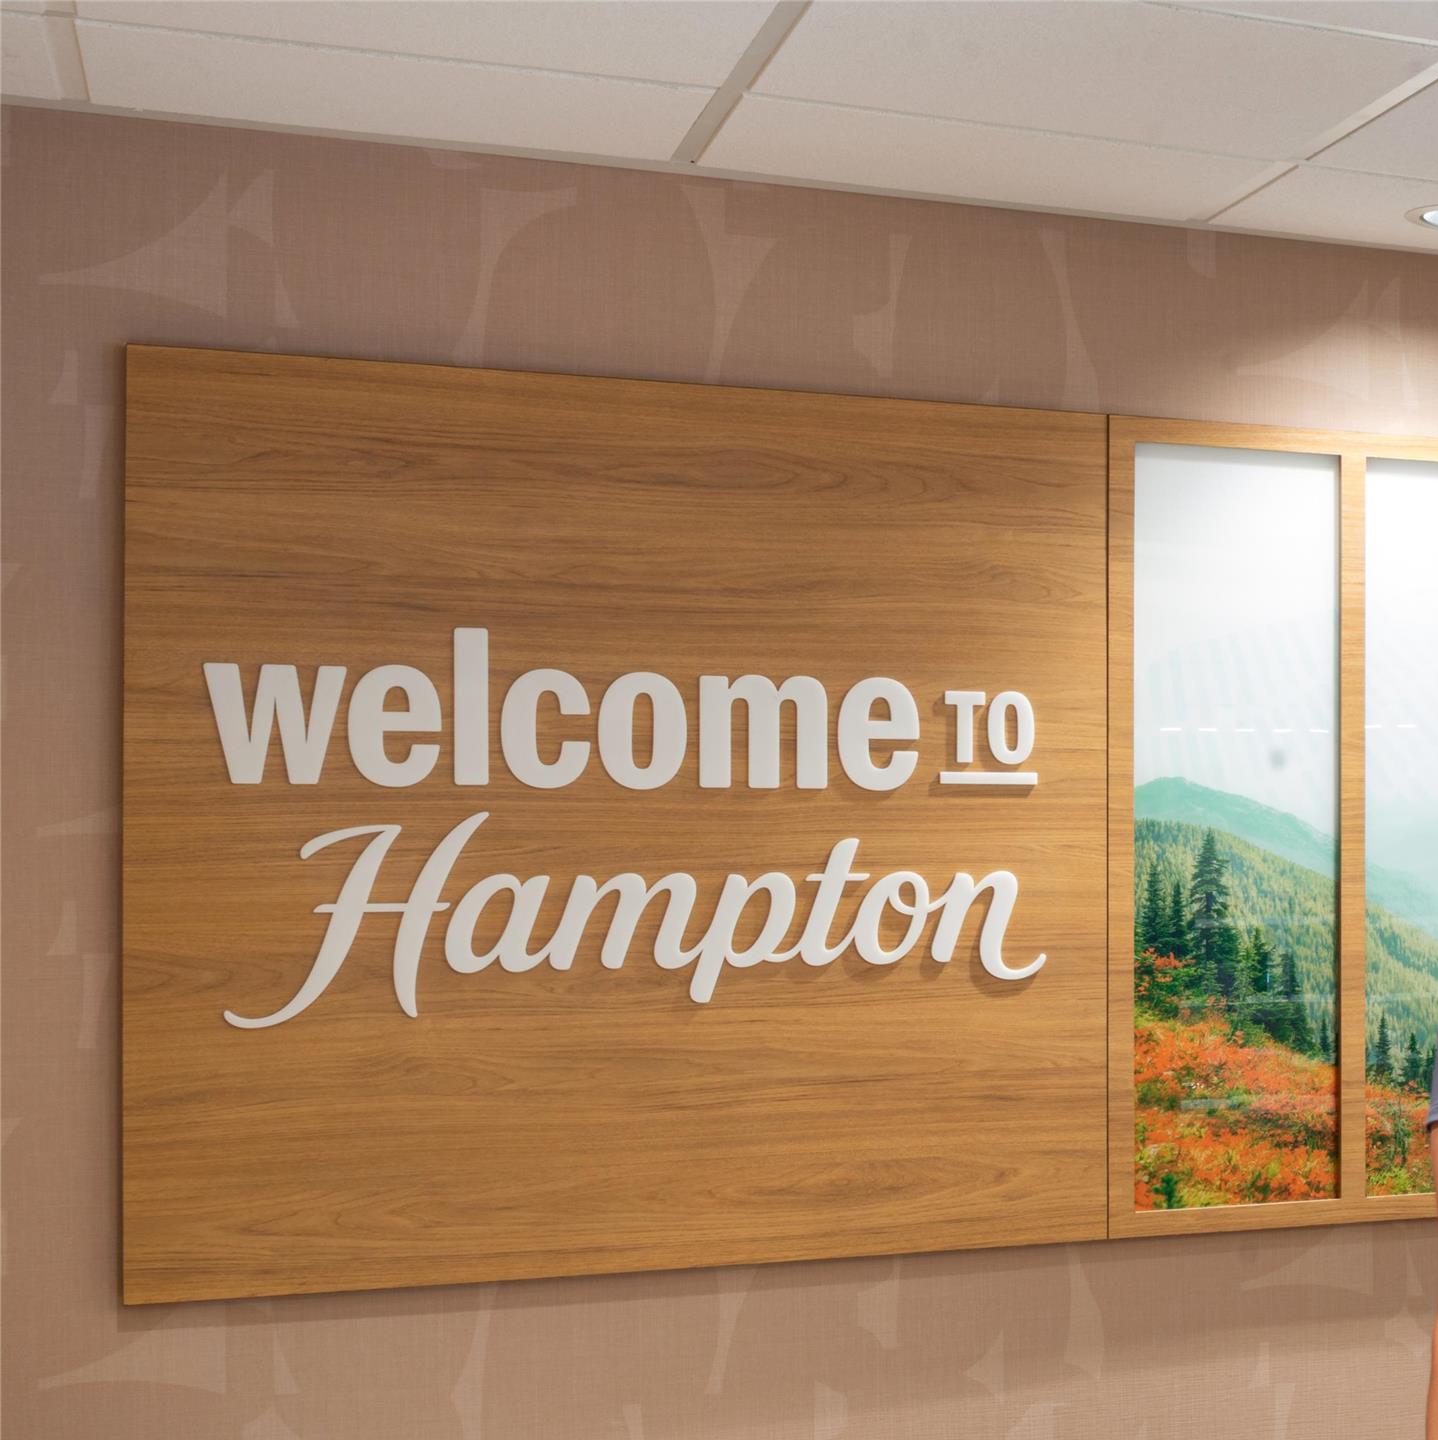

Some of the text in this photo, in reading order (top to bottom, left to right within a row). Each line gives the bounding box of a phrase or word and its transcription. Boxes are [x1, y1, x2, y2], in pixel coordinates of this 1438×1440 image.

[204, 628, 1035, 791] welcome TO
[223, 811, 1048, 1029] Hampton
